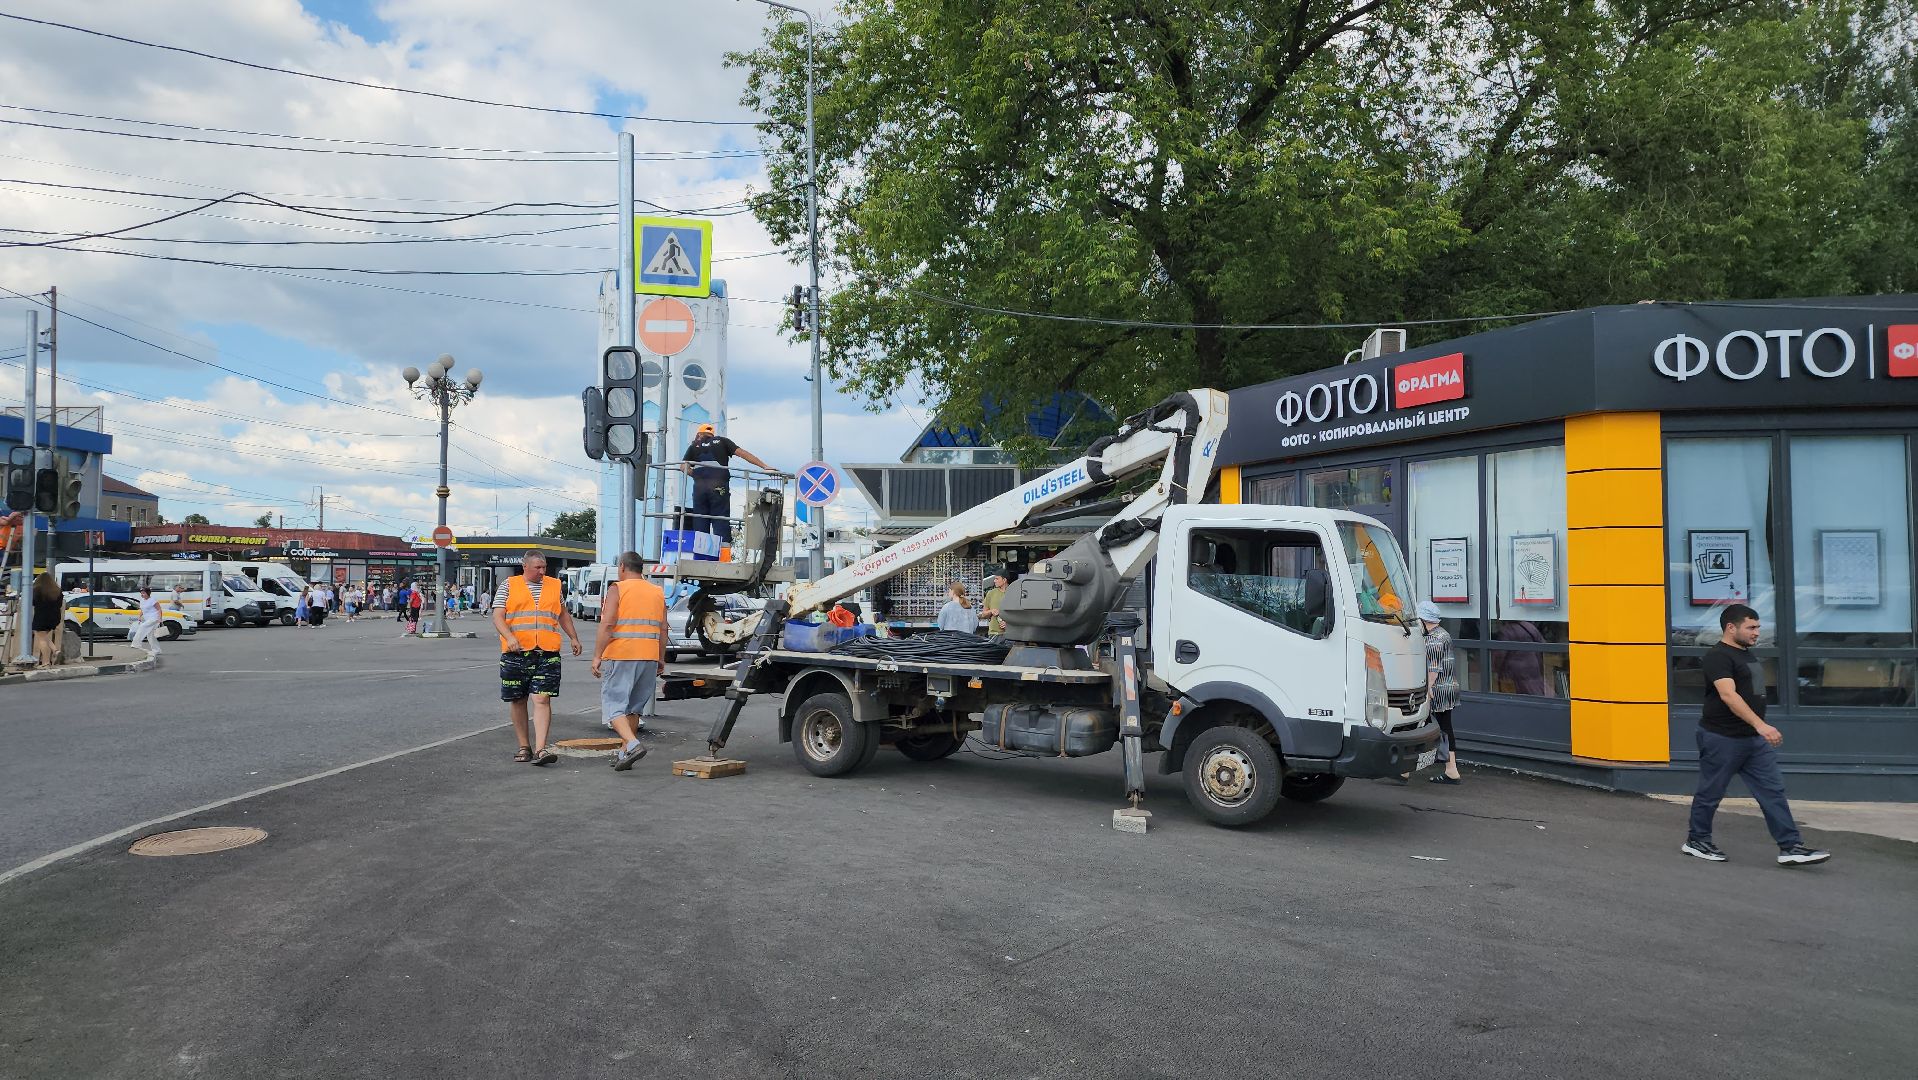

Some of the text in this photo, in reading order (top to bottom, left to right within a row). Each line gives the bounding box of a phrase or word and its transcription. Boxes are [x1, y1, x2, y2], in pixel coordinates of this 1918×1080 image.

[1653, 327, 1918, 381] ФОТО Ф
[1275, 373, 1378, 427] ФОТО
[1398, 369, 1461, 393] ФРАГМА
[1281, 406, 1470, 447] ФОТО КОПИРОВАЛЬНЫЙ ЦЕНТР
